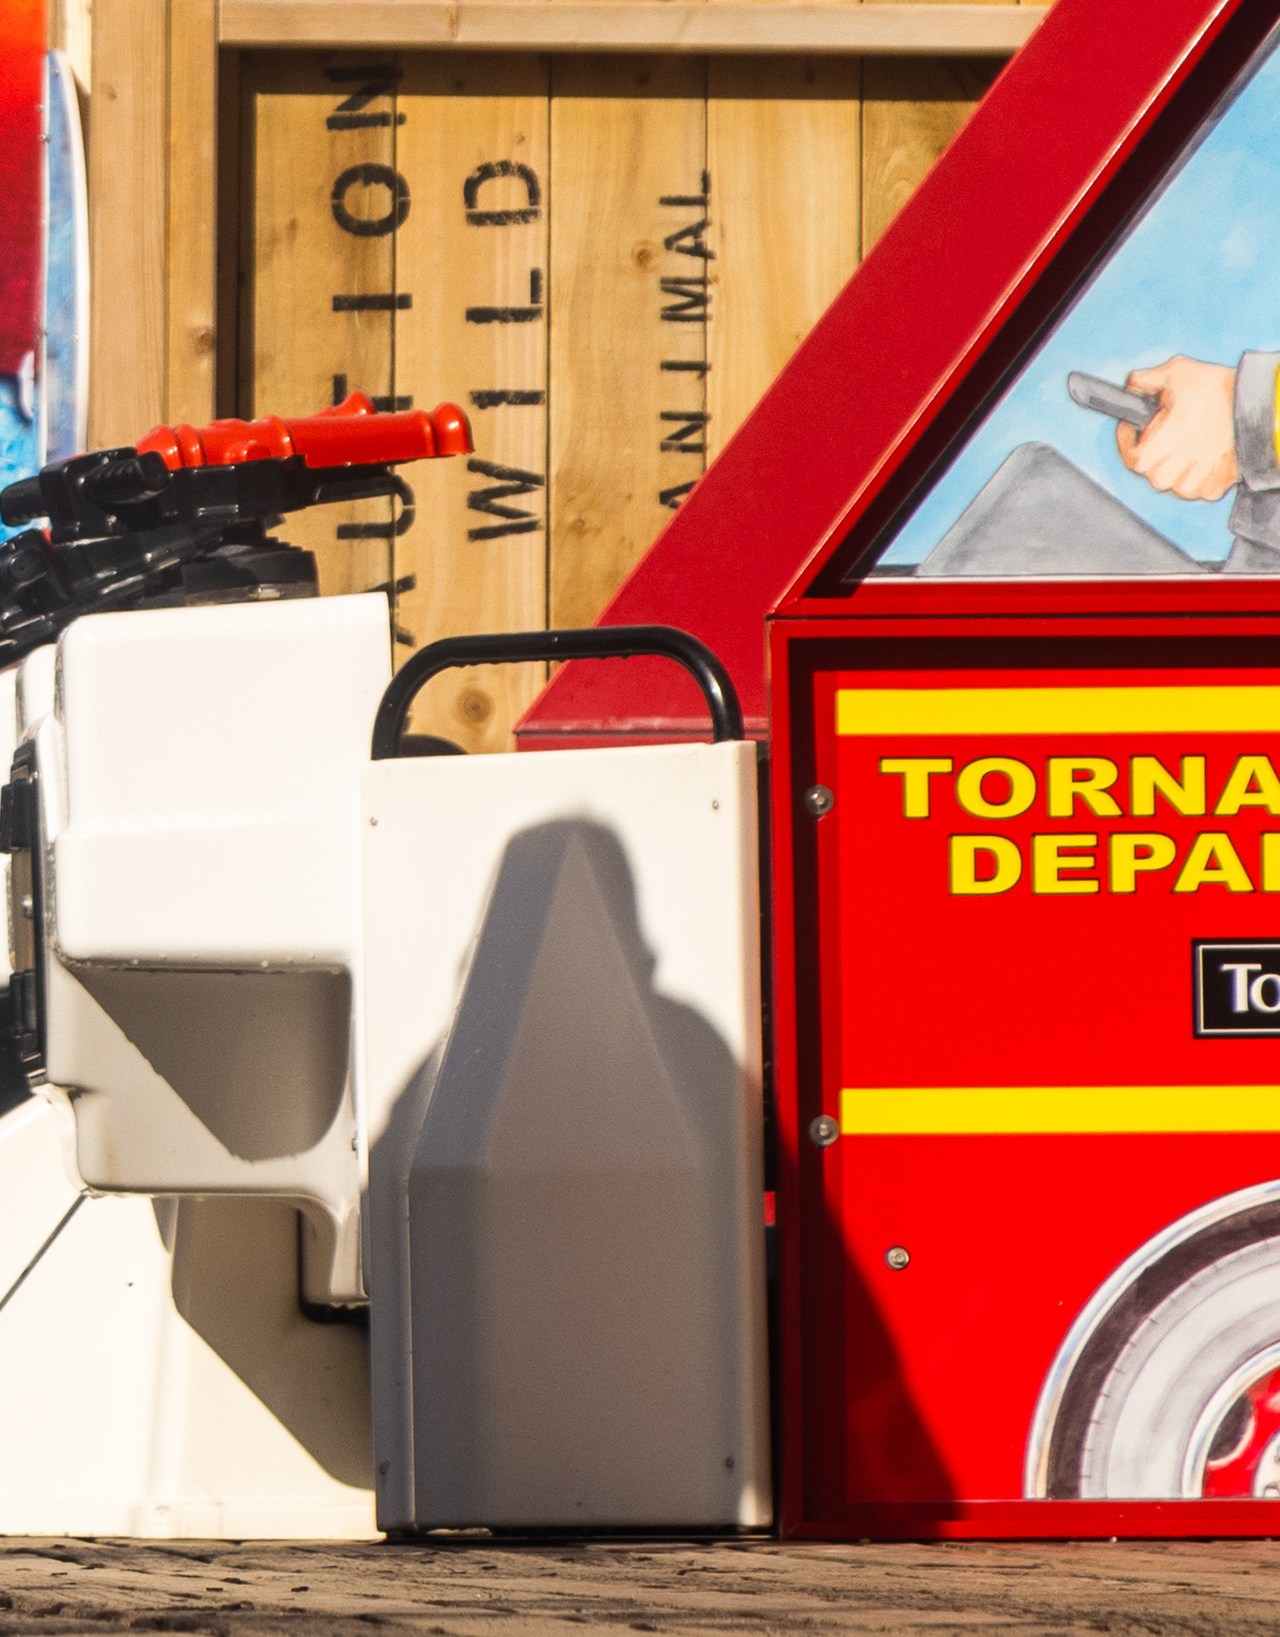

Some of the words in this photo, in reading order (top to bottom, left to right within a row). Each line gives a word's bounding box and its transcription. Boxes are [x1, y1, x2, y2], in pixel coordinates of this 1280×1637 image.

[324, 65, 416, 736] UTION
[463, 159, 546, 542] WILD
[880, 753, 1280, 820] TORNA
[1217, 963, 1280, 1014] To
